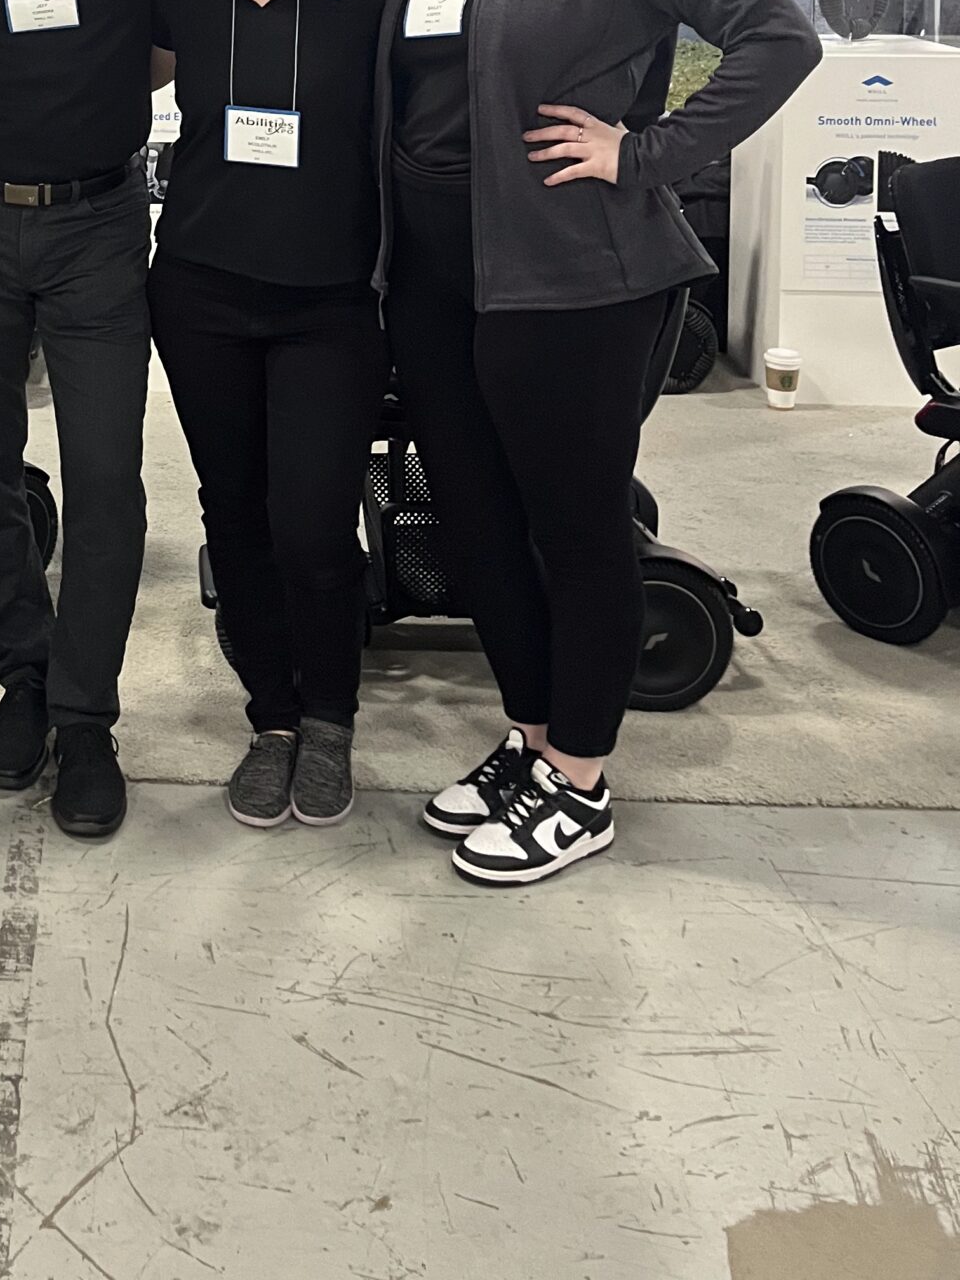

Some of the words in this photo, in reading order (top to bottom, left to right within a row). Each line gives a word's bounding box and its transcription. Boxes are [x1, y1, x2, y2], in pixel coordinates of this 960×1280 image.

[234, 116, 295, 130] Abilities
[817, 115, 862, 126] Smooth
[864, 116, 938, 127] Omni-Wheel
